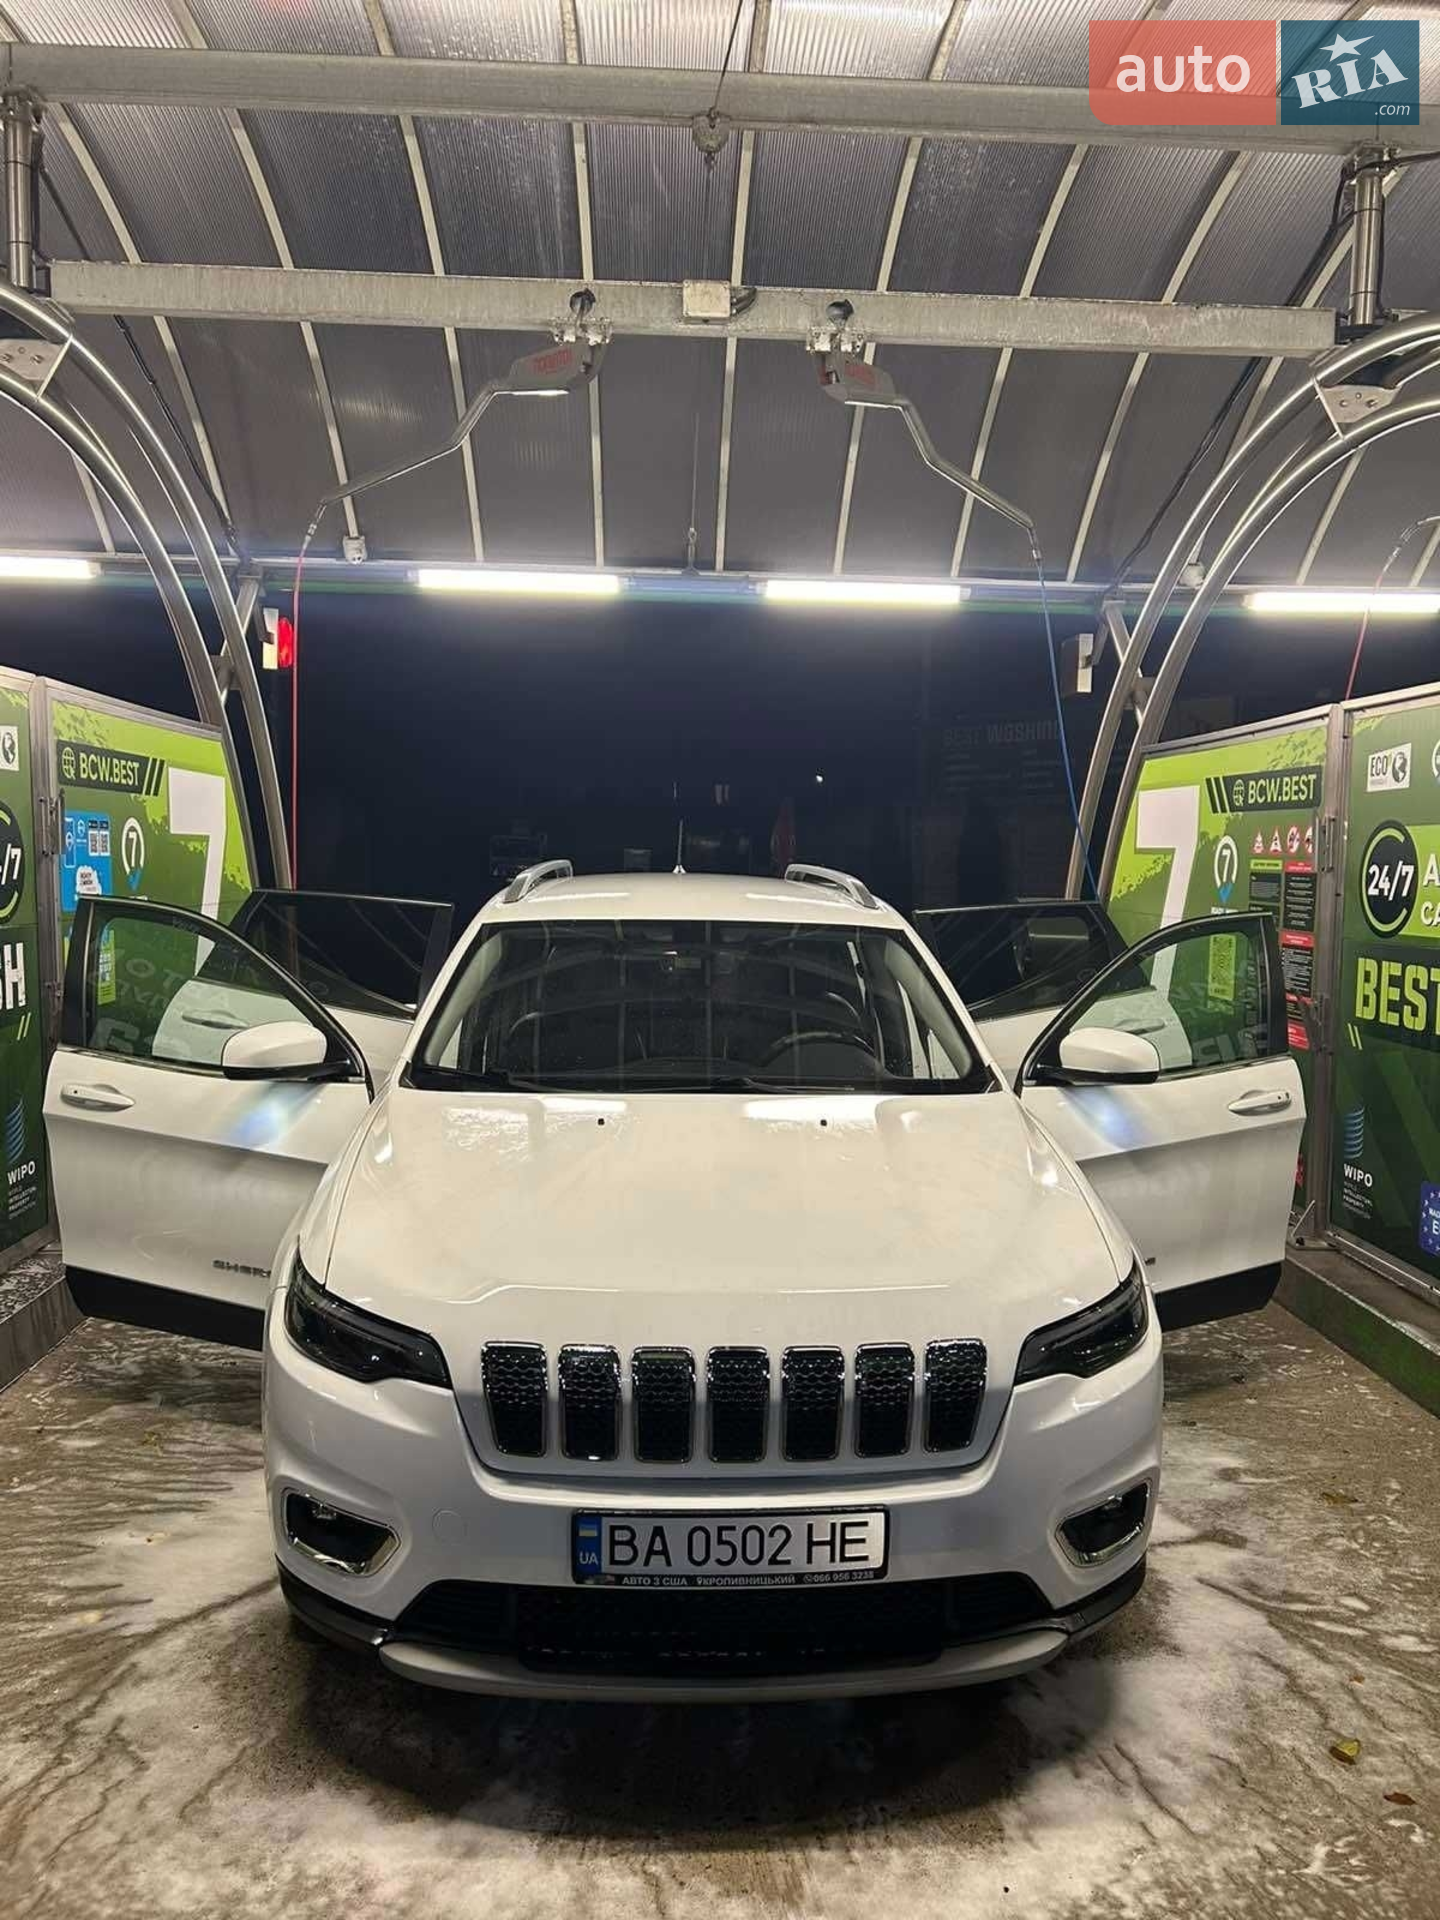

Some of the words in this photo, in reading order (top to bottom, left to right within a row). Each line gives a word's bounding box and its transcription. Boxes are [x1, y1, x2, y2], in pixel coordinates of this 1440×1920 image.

[79, 752, 140, 786] BCW.BEST
[1370, 755, 1389, 777] ECO
[1248, 774, 1317, 804] BCW.BEST
[128, 831, 137, 867] 7
[1222, 848, 1231, 883] 7
[1367, 860, 1415, 901] 24/7
[7, 1160, 36, 1185] WIPO
[1343, 1163, 1373, 1187] WIPO
[579, 1552, 598, 1565] UA
[609, 1524, 672, 1567] BA
[687, 1523, 793, 1567] 0502
[806, 1520, 869, 1565] HE
[622, 1576, 651, 1586] АВТО
[662, 1576, 688, 1586] США
